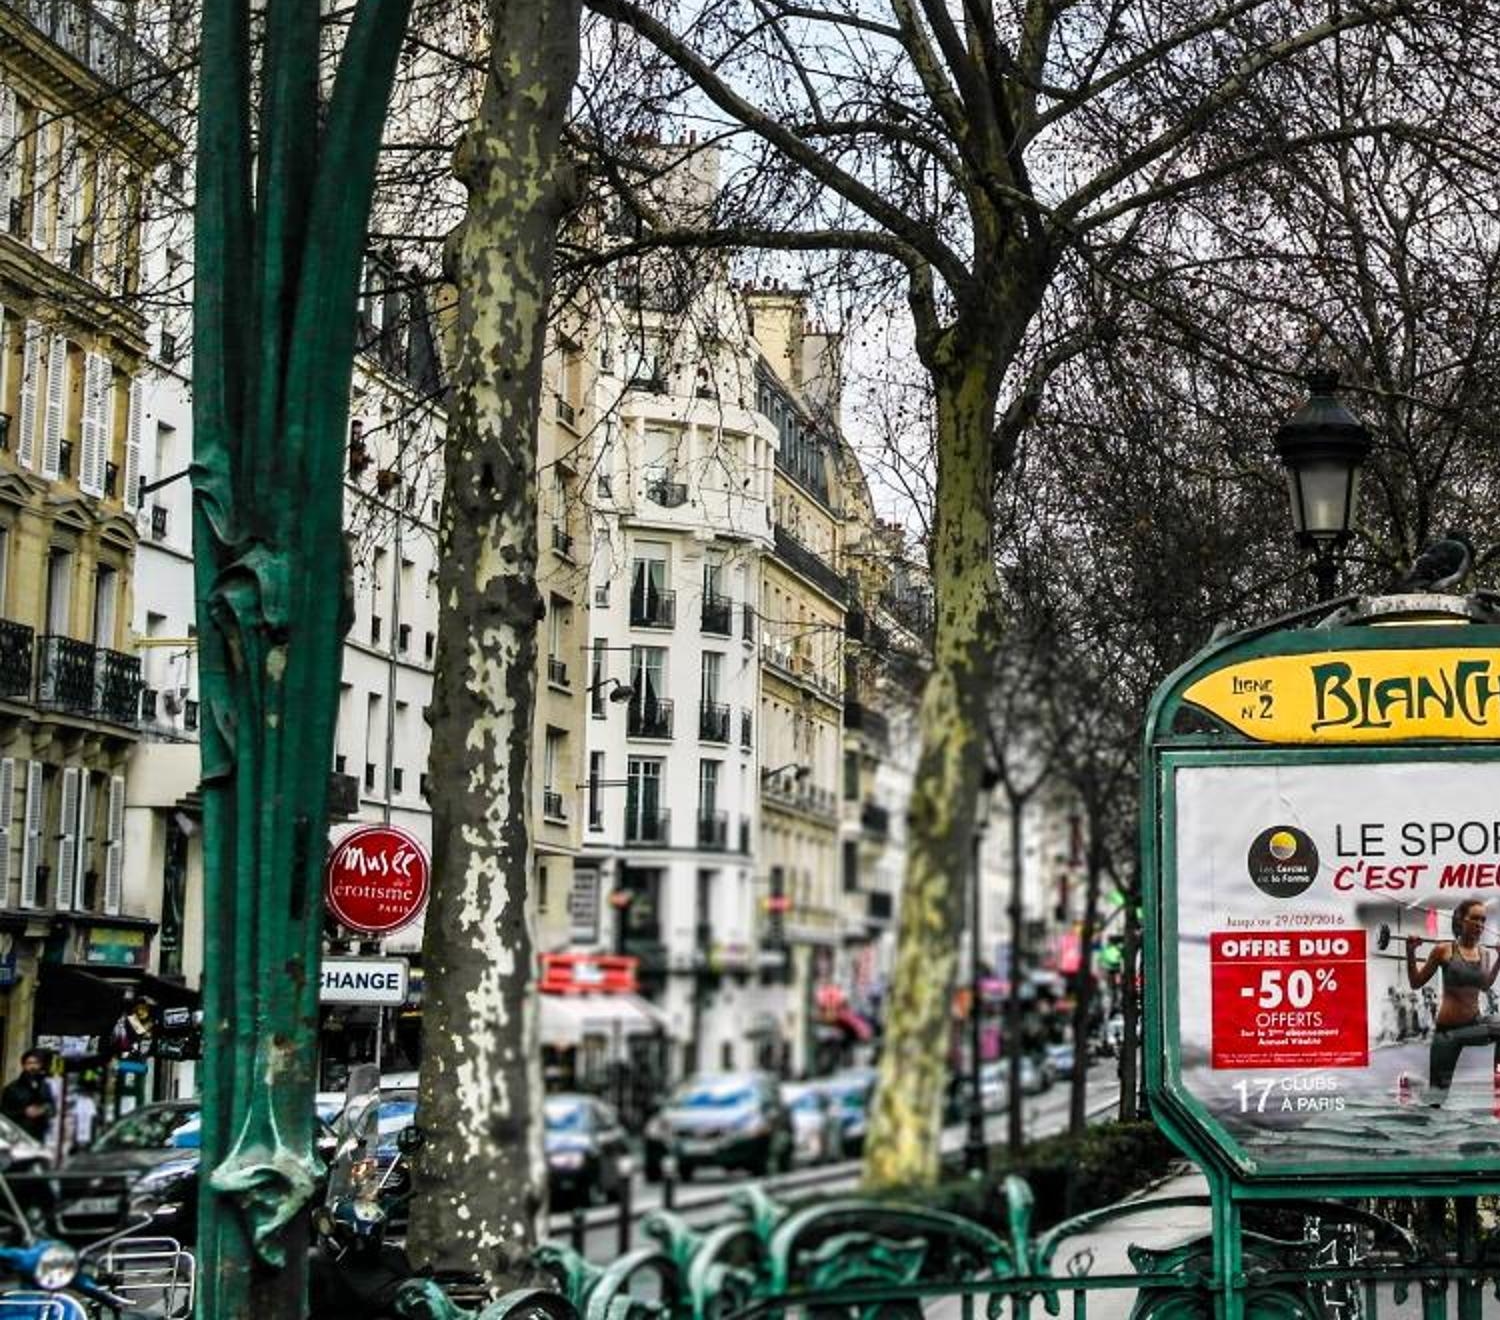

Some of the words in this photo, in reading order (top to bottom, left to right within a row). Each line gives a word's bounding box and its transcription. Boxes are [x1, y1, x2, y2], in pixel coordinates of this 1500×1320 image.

[1335, 823, 1386, 857] LE
[339, 843, 417, 878] Musée
[1333, 860, 1428, 891] C'EST
[1221, 939, 1291, 957] OFFRE
[1299, 938, 1350, 957] DUO
[1256, 1011, 1323, 1027] OFFERTS
[1232, 1078, 1275, 1113] 17
[1281, 1077, 1337, 1091] CLUBS
[1297, 1097, 1345, 1112] PARIS
